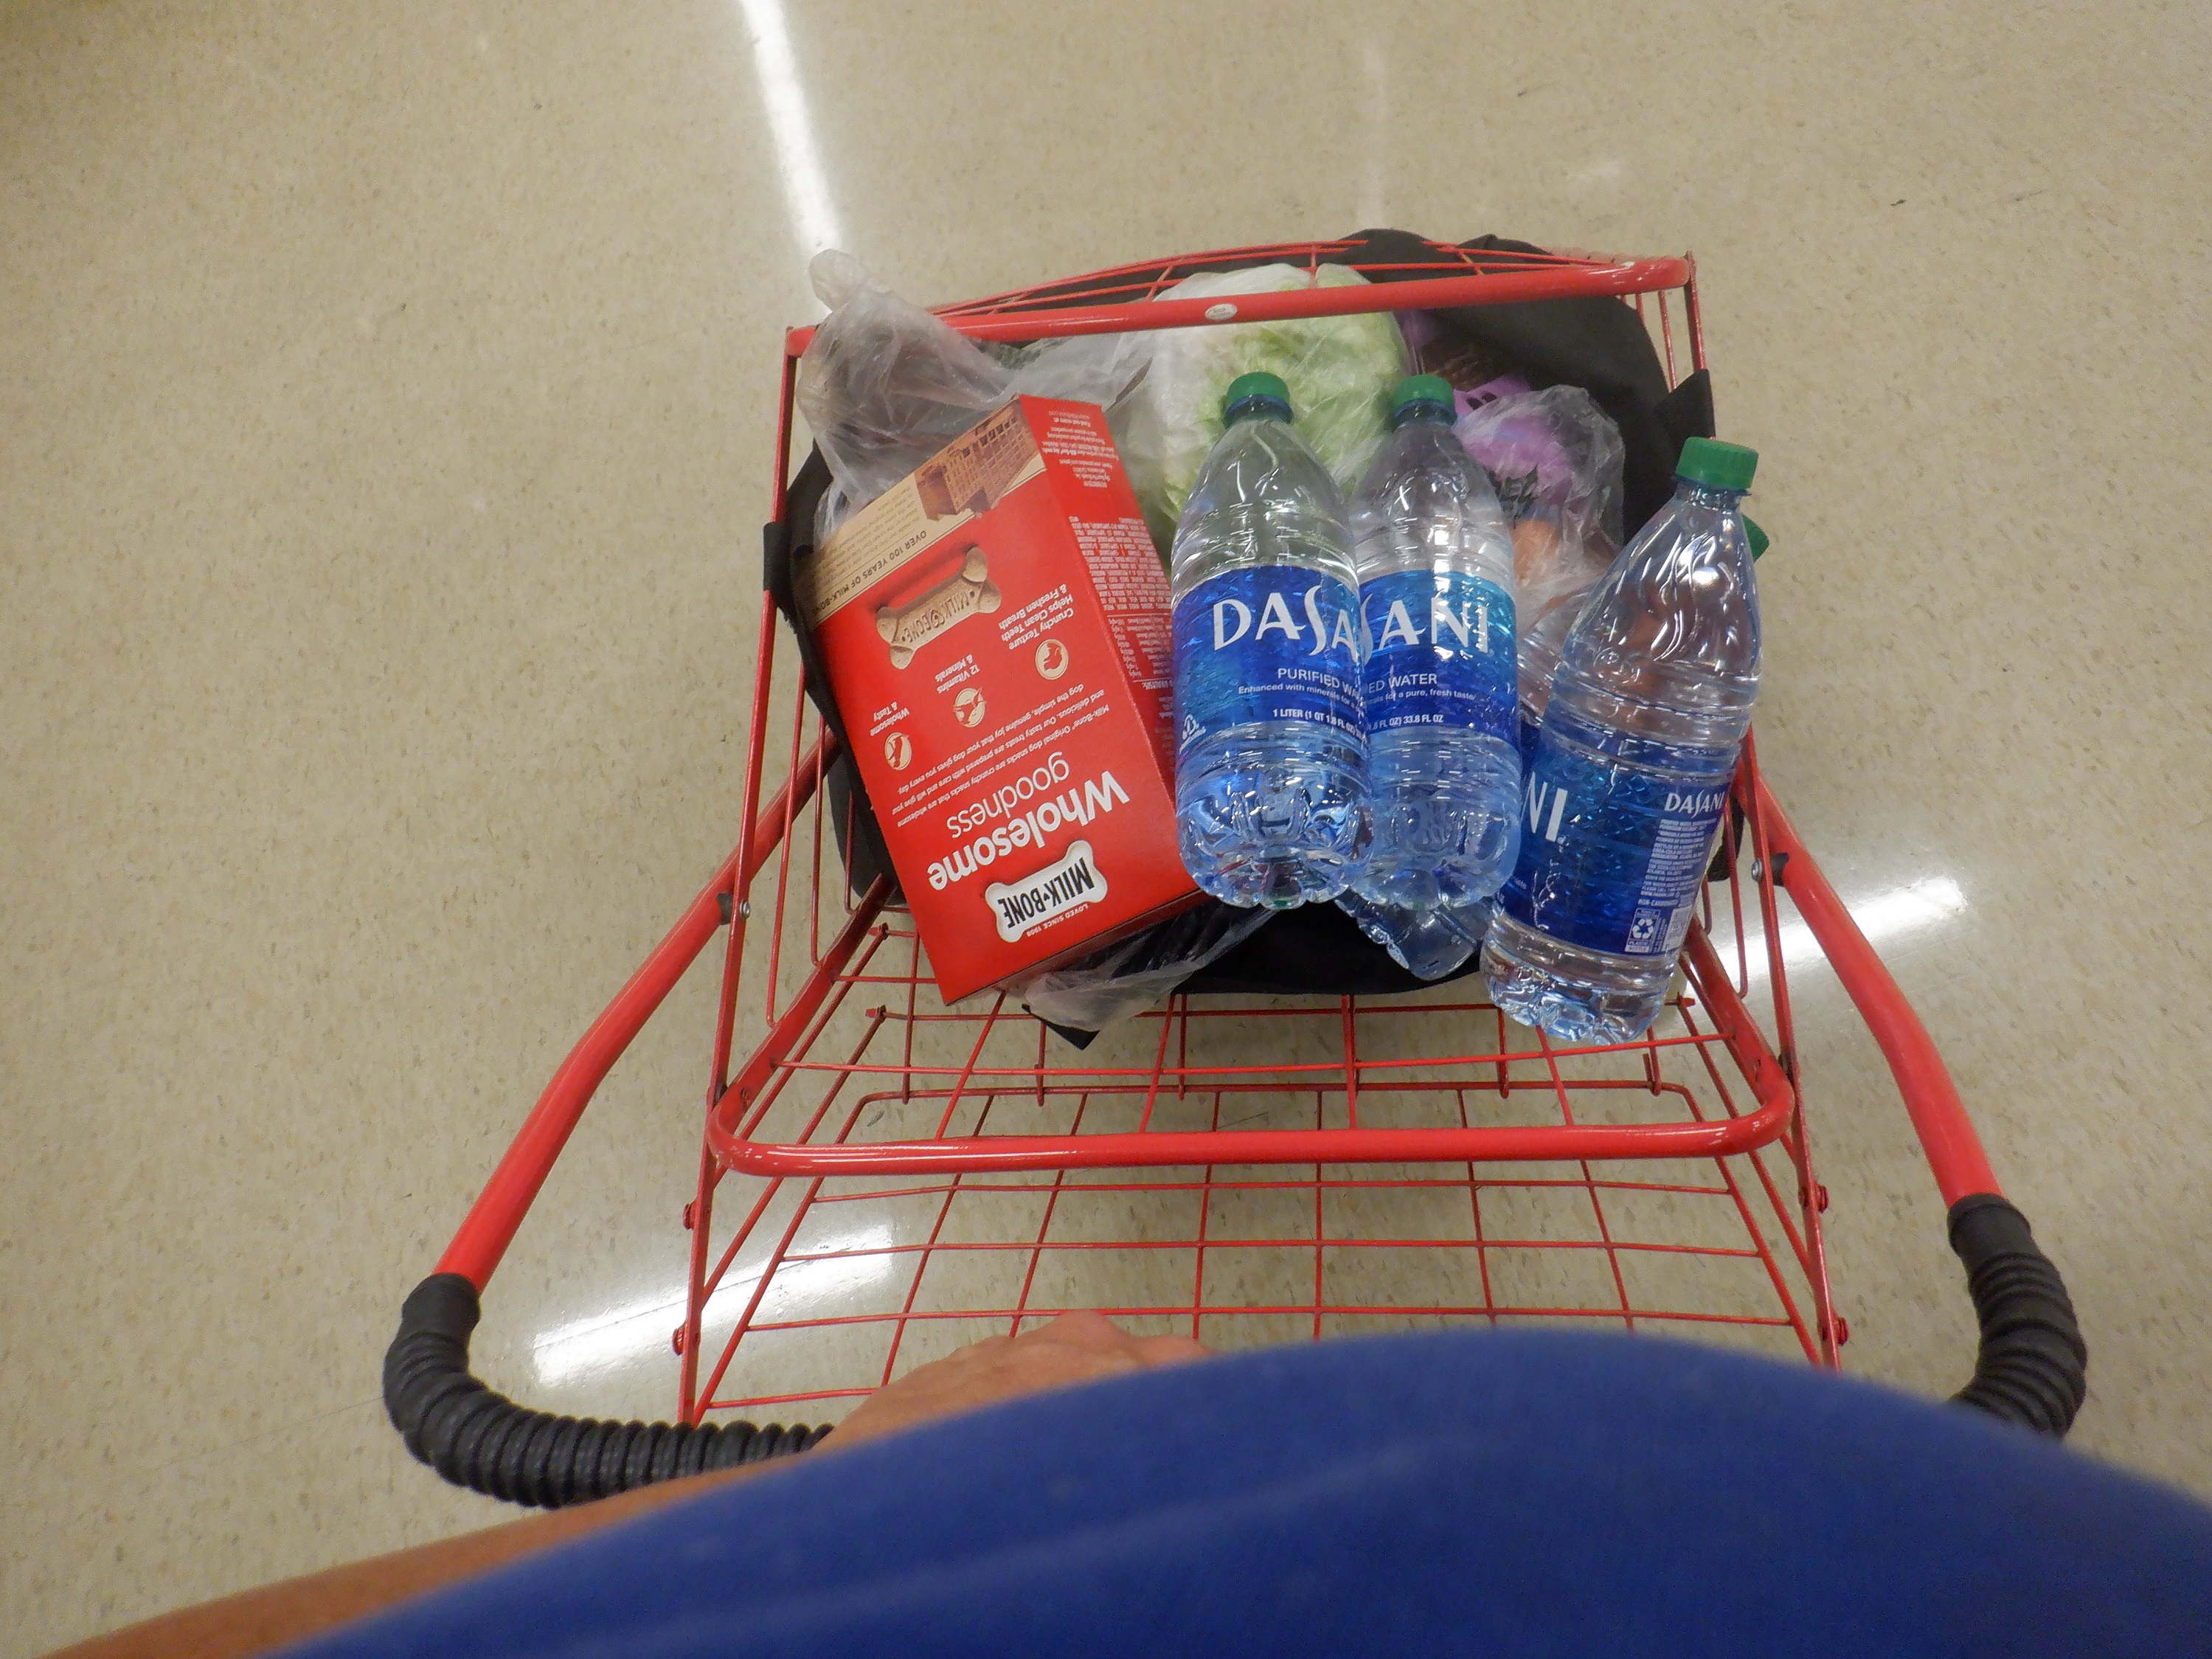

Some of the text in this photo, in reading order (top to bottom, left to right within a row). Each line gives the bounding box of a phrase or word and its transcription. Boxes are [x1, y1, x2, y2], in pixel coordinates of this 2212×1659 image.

[902, 529, 929, 550] OVER
[887, 545, 905, 561] 100
[860, 557, 888, 579] YEARS
[847, 575, 862, 588] OF
[999, 584, 1067, 629] & Freshen Breath
[1002, 594, 1072, 641] Helps Clean Teeth
[1009, 608, 1074, 649] Crunchy Texture
[935, 654, 973, 682] & Minerals
[937, 665, 980, 693] 12 Vitamins
[1278, 668, 1340, 689] PURIFIED
[1388, 673, 1438, 688] WATER
[1069, 684, 1084, 696] dog
[1238, 683, 1283, 694] Enhanced
[1286, 683, 1305, 692] with
[1406, 689, 1427, 700] pure,
[1429, 688, 1452, 697] fresh
[1057, 693, 1069, 702] the
[1090, 690, 1104, 702] and
[874, 702, 897, 721] & Tasty
[1031, 699, 1055, 716] simple,
[1056, 698, 1089, 718] delicious.
[1273, 708, 1277, 717] 1
[1280, 708, 1303, 718] LITER
[1314, 711, 1325, 721] QT
[870, 707, 909, 735] Wholesome
[1005, 712, 1031, 731] genuine
[1044, 716, 1056, 727] Our
[1389, 717, 1401, 727] OZ)
[1404, 716, 1420, 724] 33.8
[1422, 715, 1431, 723] FL
[1432, 714, 1444, 723] OZ
[995, 727, 1005, 738] joy
[1026, 724, 1042, 737] tasty
[1043, 726, 1070, 745] Original
[967, 741, 981, 755] your
[980, 735, 994, 747] that
[1005, 734, 1024, 748] treats
[1029, 741, 1042, 752] dog
[953, 751, 965, 762] dog
[994, 745, 1005, 755] are
[1006, 748, 1028, 764] snacks
[937, 758, 953, 771] gives
[965, 749, 994, 772] prepared
[995, 761, 1006, 770] are
[925, 767, 937, 778] you
[951, 768, 965, 779] with
[971, 767, 995, 784] crunchy
[910, 775, 925, 788] every
[938, 775, 951, 786] care
[926, 783, 938, 795] and
[947, 752, 1069, 838] goodness
[950, 780, 970, 796] snacks
[904, 795, 916, 807] give
[928, 800, 937, 809] are
[937, 793, 950, 804] that
[1664, 789, 1725, 819] DASANI
[892, 803, 904, 815] your
[927, 771, 1130, 890] Wholesome
[1065, 904, 1088, 918] LOVED
[1043, 915, 1064, 929] SINCE
